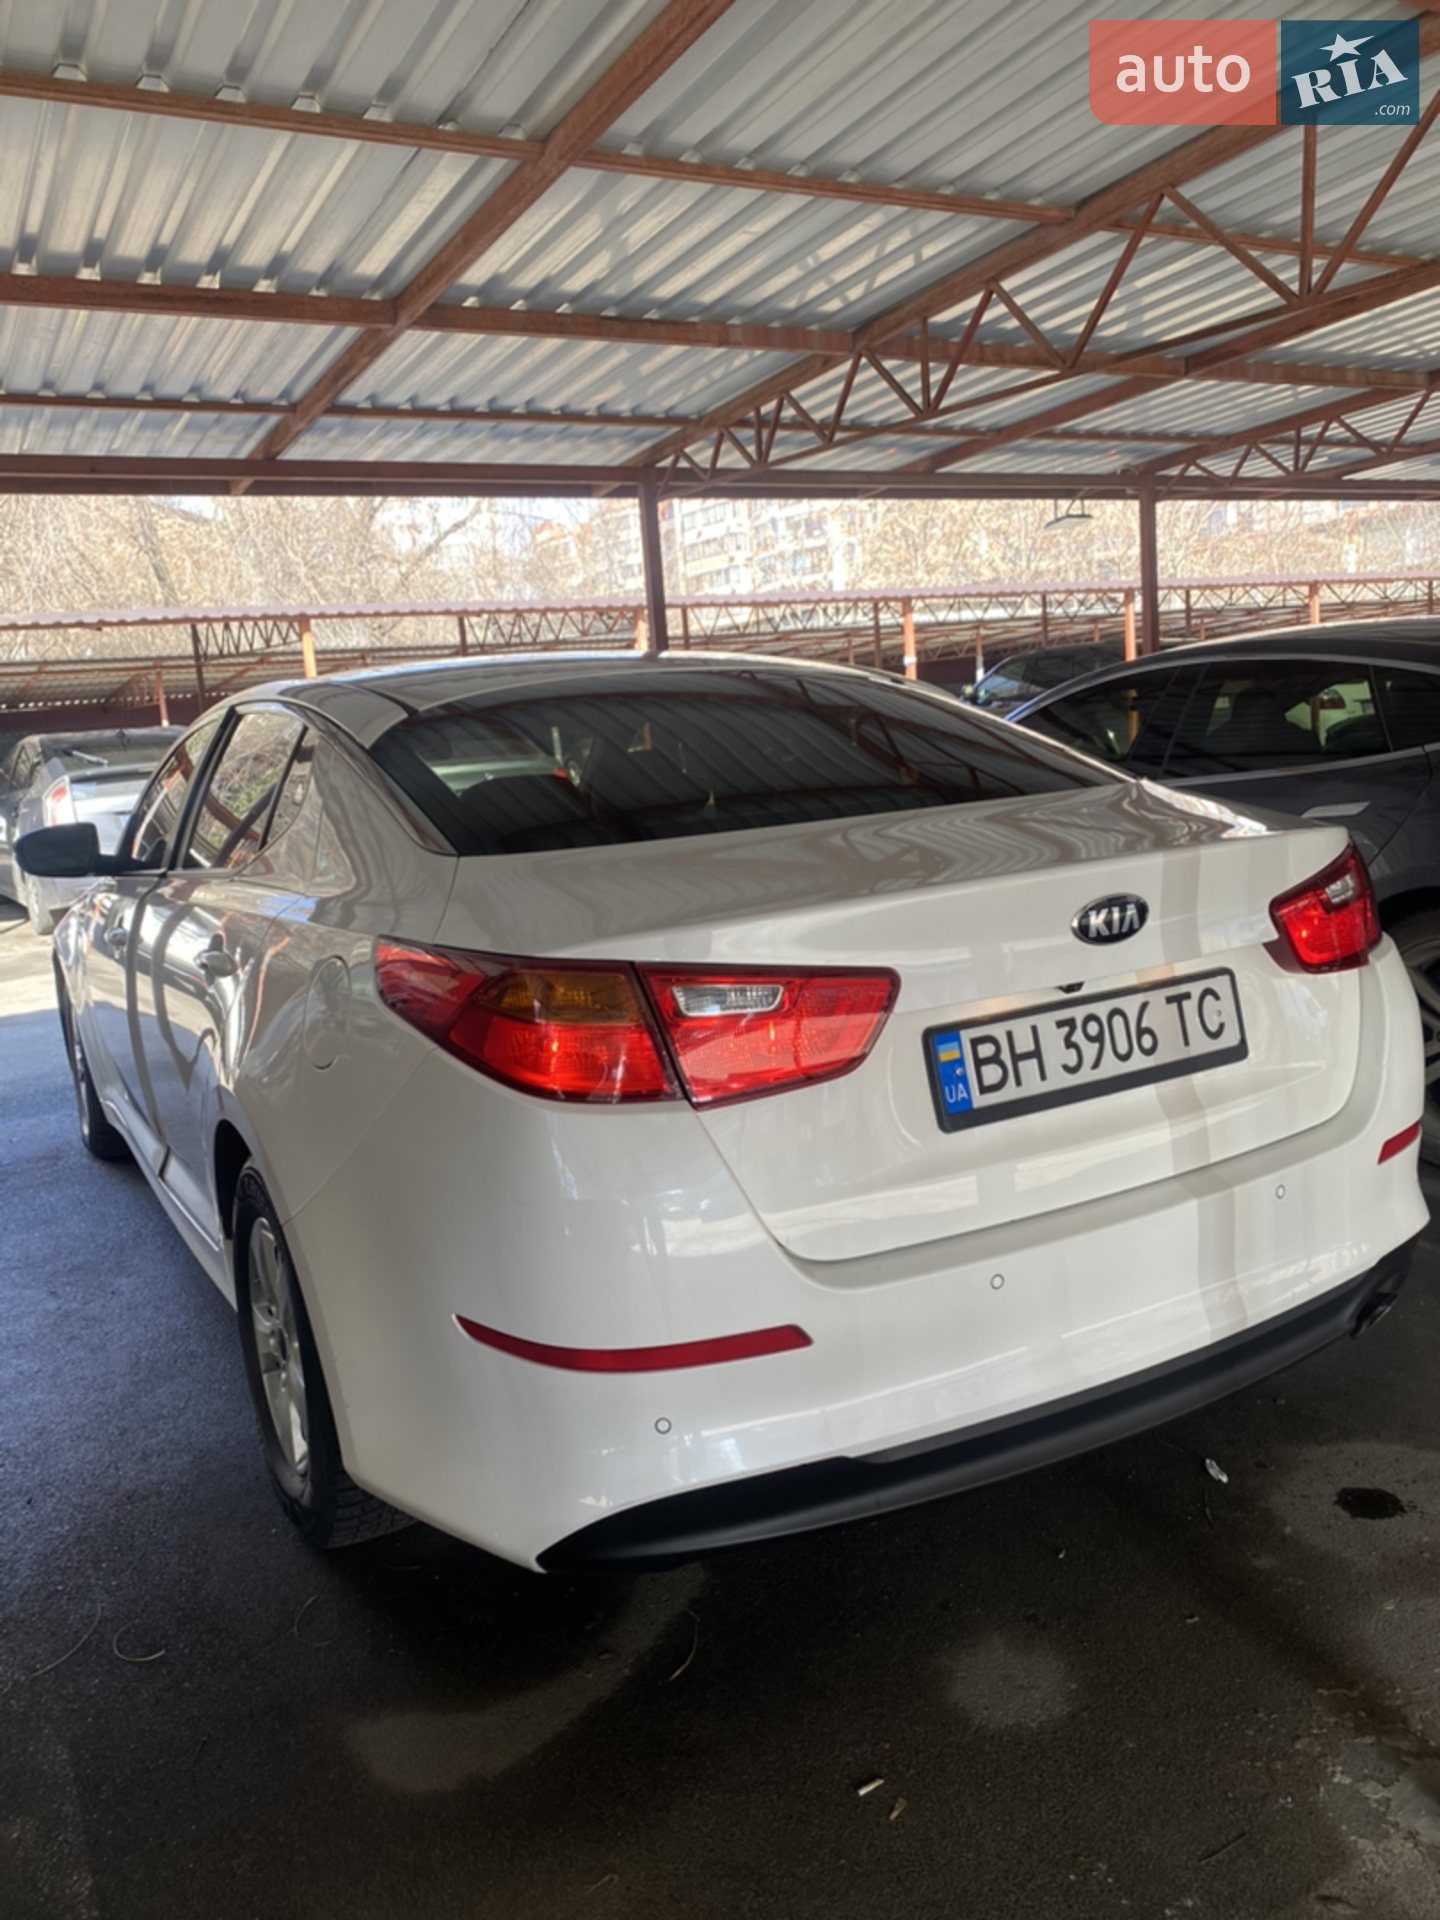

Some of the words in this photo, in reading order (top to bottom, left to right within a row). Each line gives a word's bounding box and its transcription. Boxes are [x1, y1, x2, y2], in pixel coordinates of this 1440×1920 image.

[1088, 903, 1141, 938] KIA
[970, 1024, 1047, 1095] BH
[1056, 1001, 1158, 1075] 3906
[1165, 987, 1225, 1047] TC
[944, 1082, 970, 1104] UA
